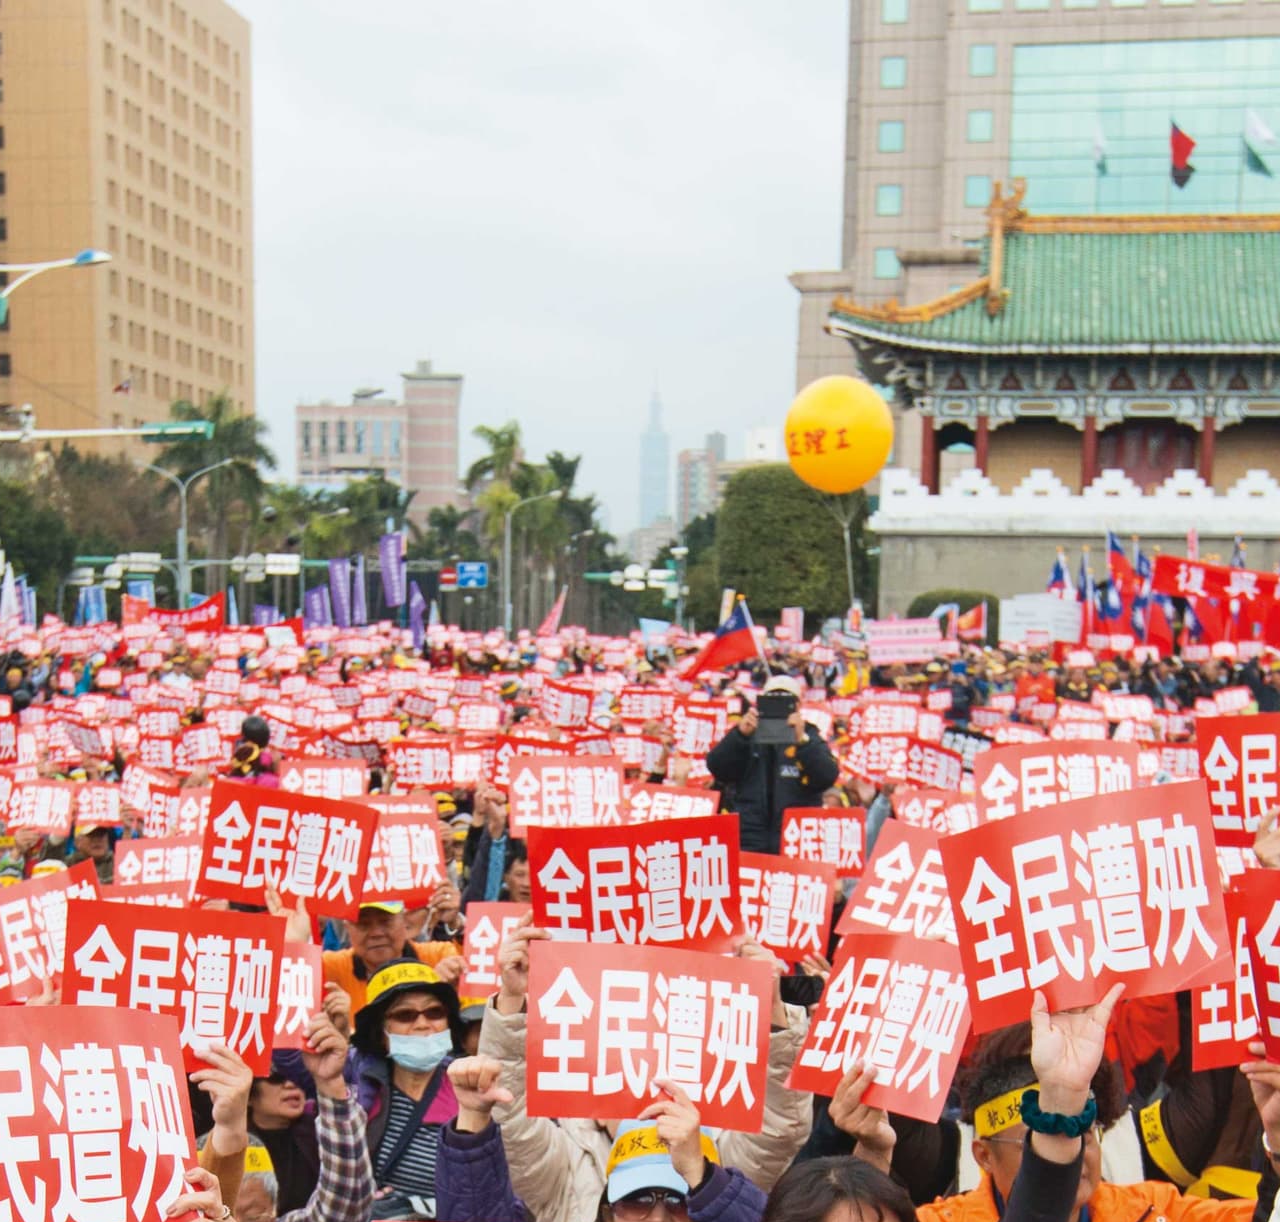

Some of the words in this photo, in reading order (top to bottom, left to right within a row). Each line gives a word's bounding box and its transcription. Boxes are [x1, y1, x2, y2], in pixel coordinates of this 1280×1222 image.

[513, 765, 622, 827] 全民遭殃
[981, 753, 1133, 821] 全民遭殃
[204, 800, 363, 905] 全民遭殃
[537, 835, 734, 945] 全民遭殃
[960, 813, 1219, 1001] 全民遭殃
[73, 923, 275, 1057] 全民遭殃
[536, 965, 761, 1112] 全民遭殃
[799, 957, 970, 1100] 全民遭殃
[613, 1131, 670, 1159] 執政無
[986, 1097, 1023, 1130] 執政
